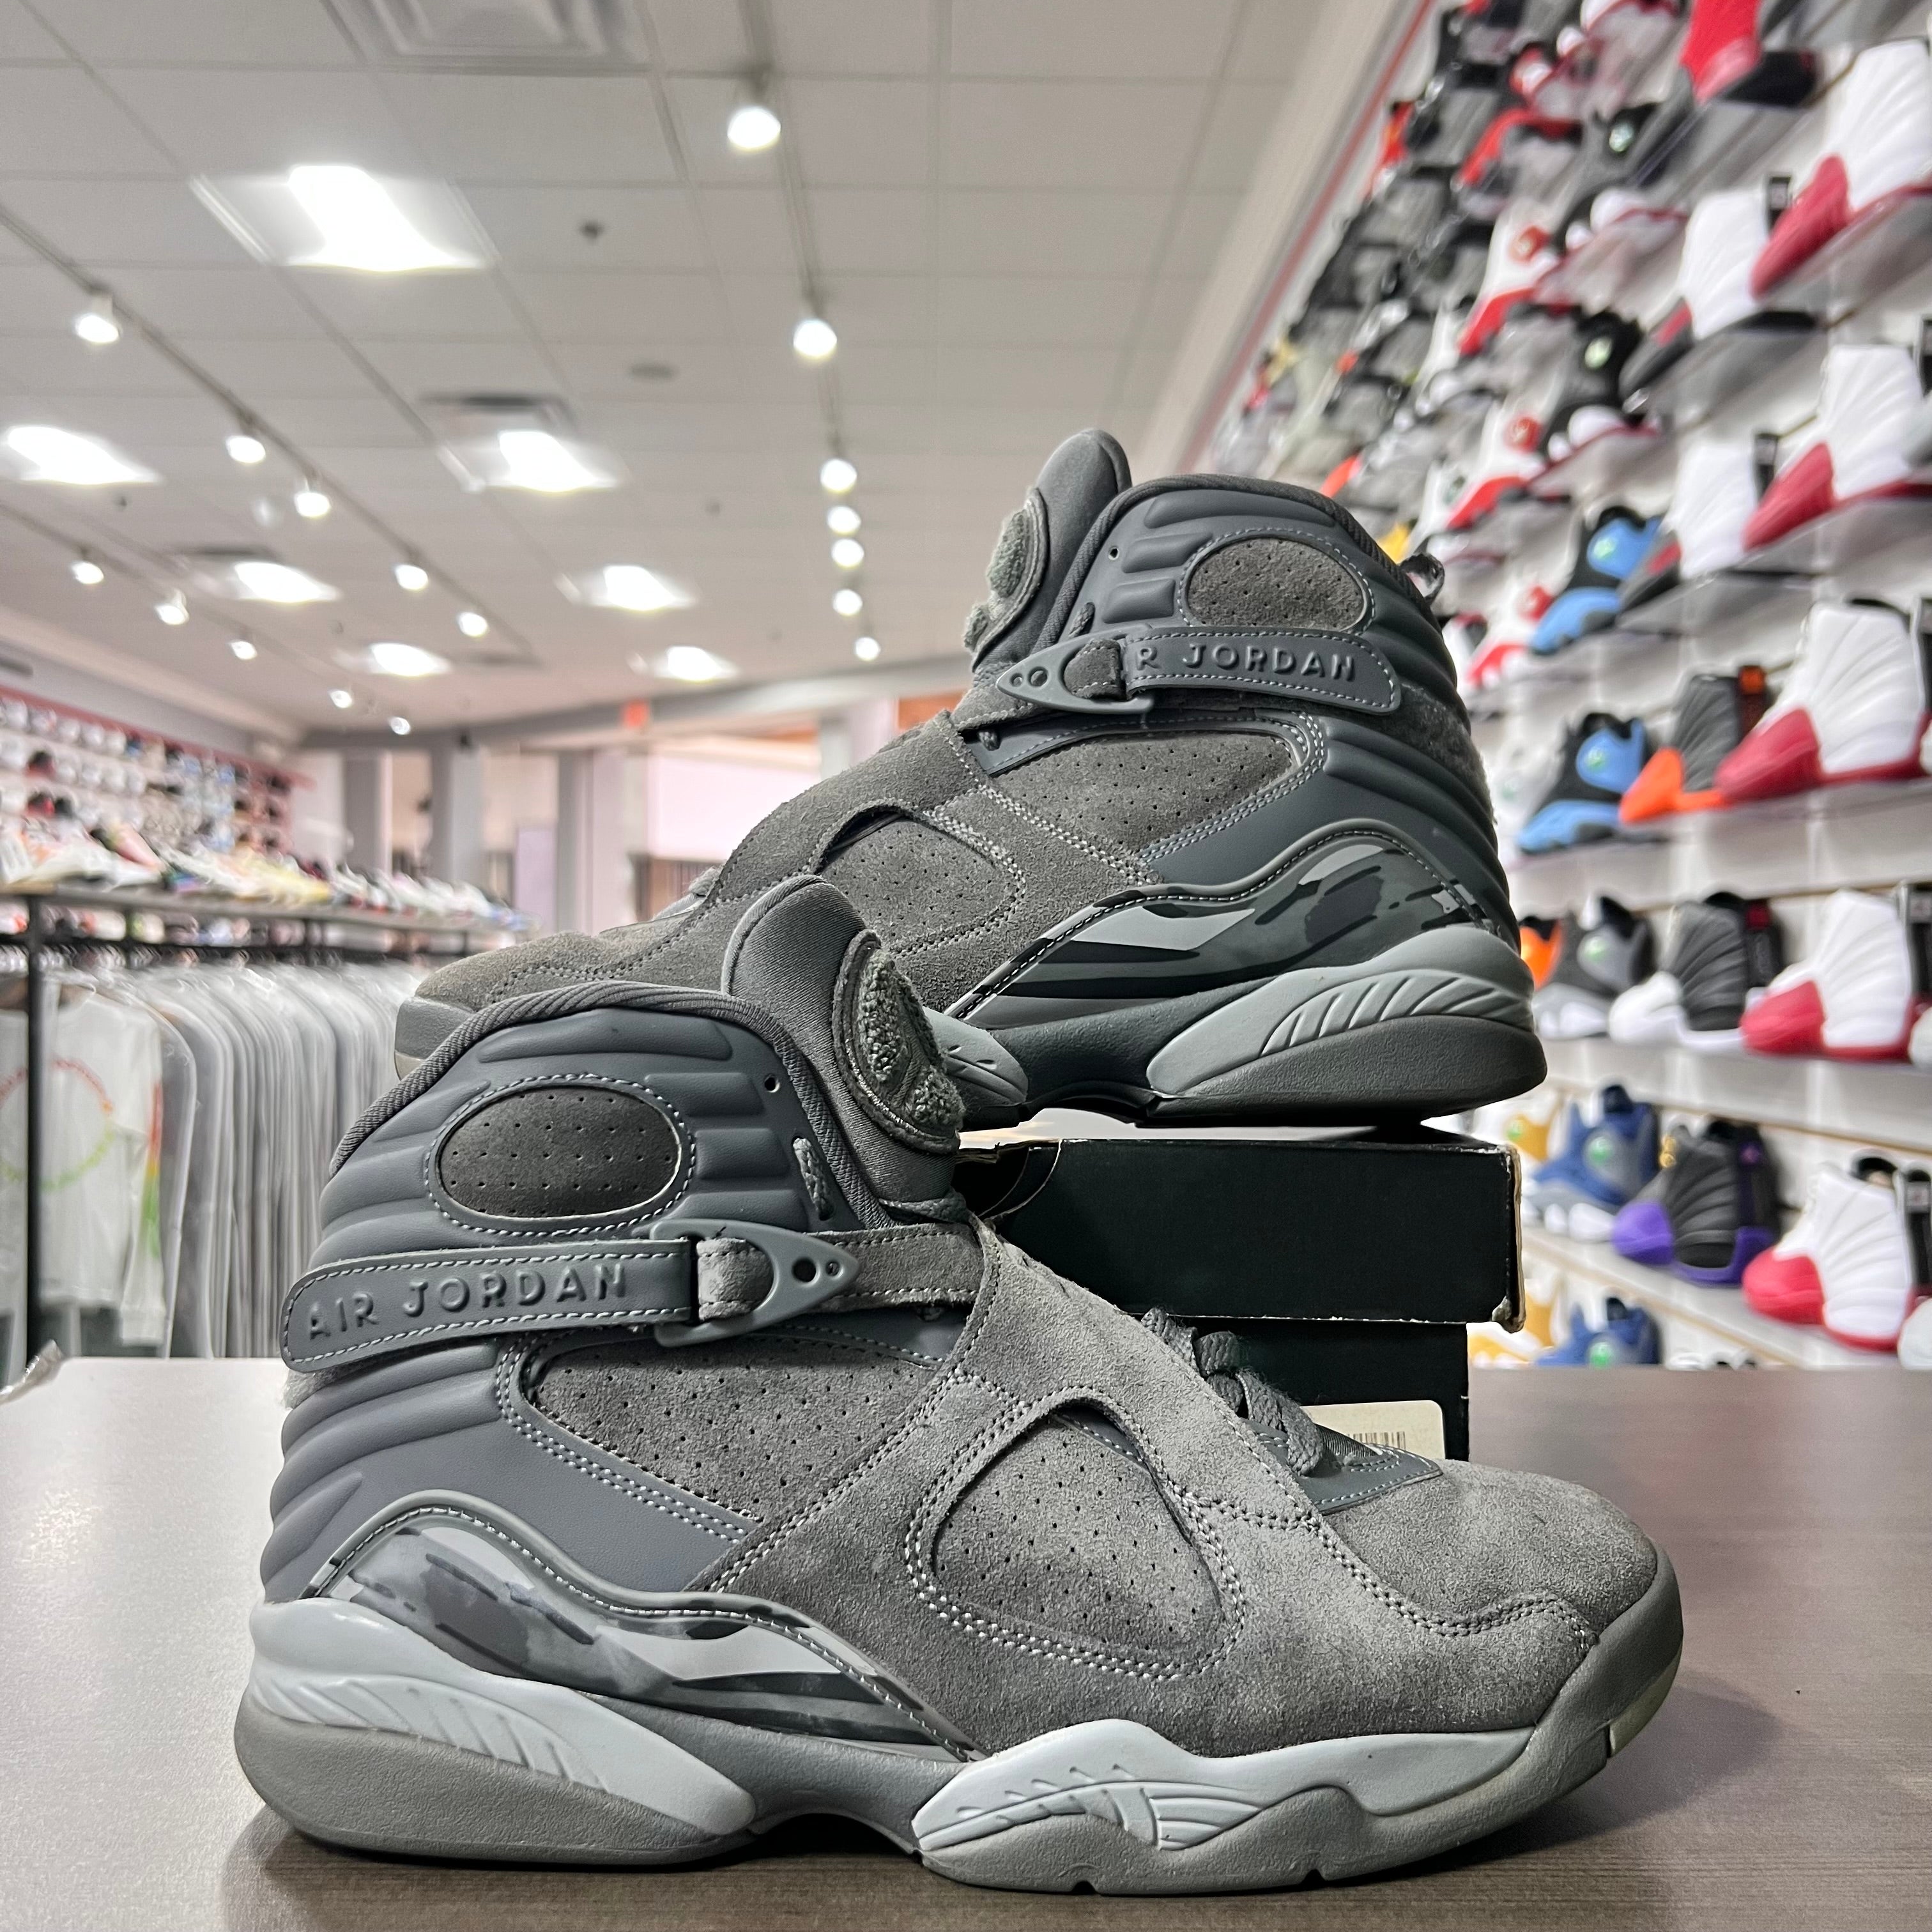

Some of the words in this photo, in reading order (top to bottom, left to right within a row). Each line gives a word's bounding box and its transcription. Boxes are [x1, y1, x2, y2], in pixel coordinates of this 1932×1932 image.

[1182, 643, 1356, 682] JORDAN
[309, 1291, 379, 1340] AIR
[403, 1263, 626, 1317] JORDAN
